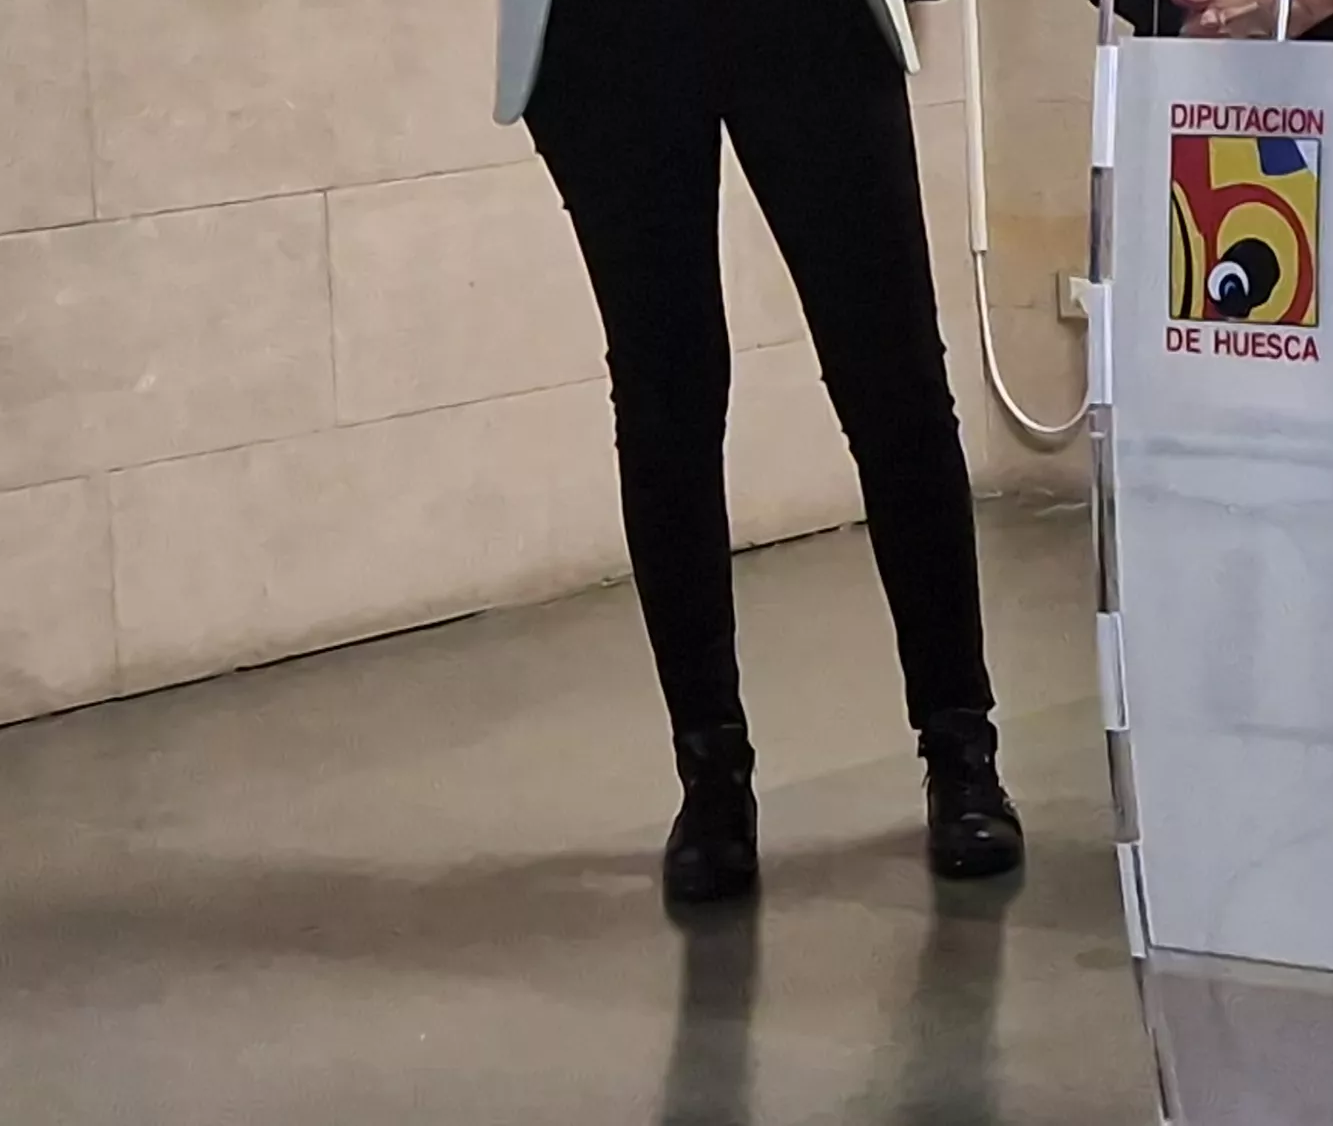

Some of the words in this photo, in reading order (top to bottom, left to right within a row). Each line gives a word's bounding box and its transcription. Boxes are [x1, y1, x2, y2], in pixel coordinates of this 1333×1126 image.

[1170, 103, 1324, 135] DIPUTACION
[1166, 327, 1202, 354] DE
[1214, 329, 1319, 361] HUESCA
